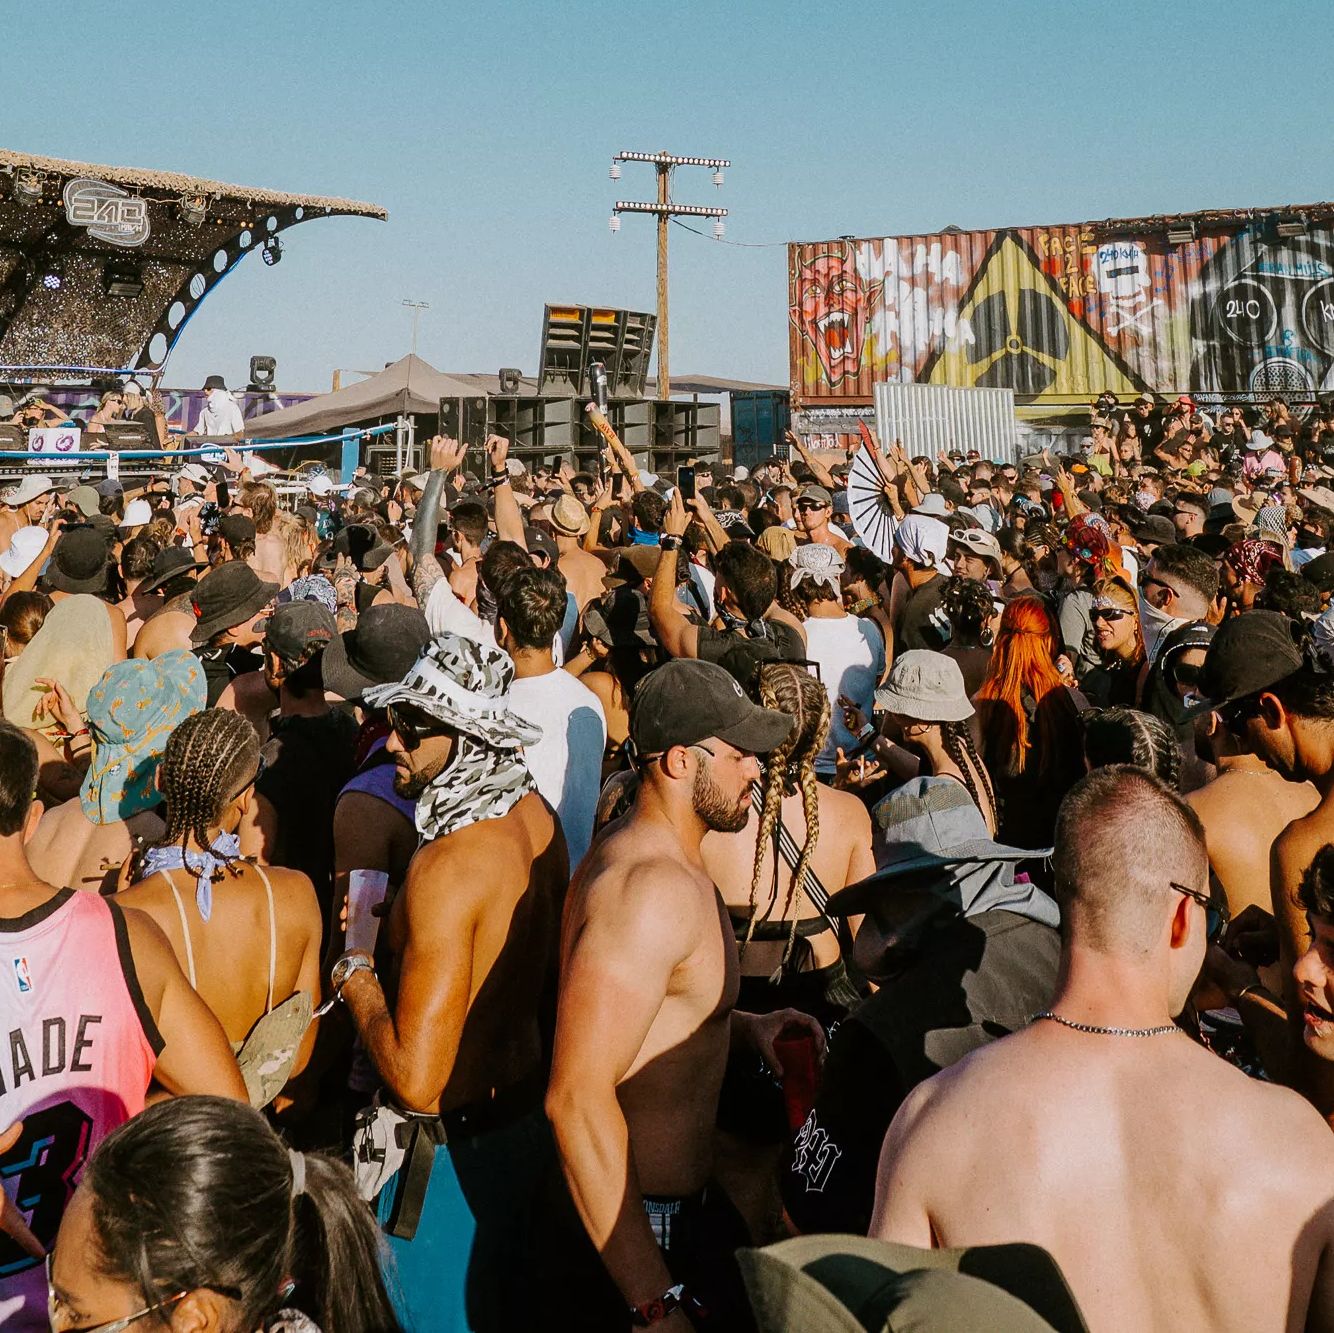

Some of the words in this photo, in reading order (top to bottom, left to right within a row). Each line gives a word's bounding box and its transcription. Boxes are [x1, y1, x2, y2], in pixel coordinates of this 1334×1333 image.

[1038, 232, 1098, 257] FACE
[1065, 253, 1080, 274] 2
[1058, 275, 1098, 298] FACE
[1225, 299, 1261, 320] 240
